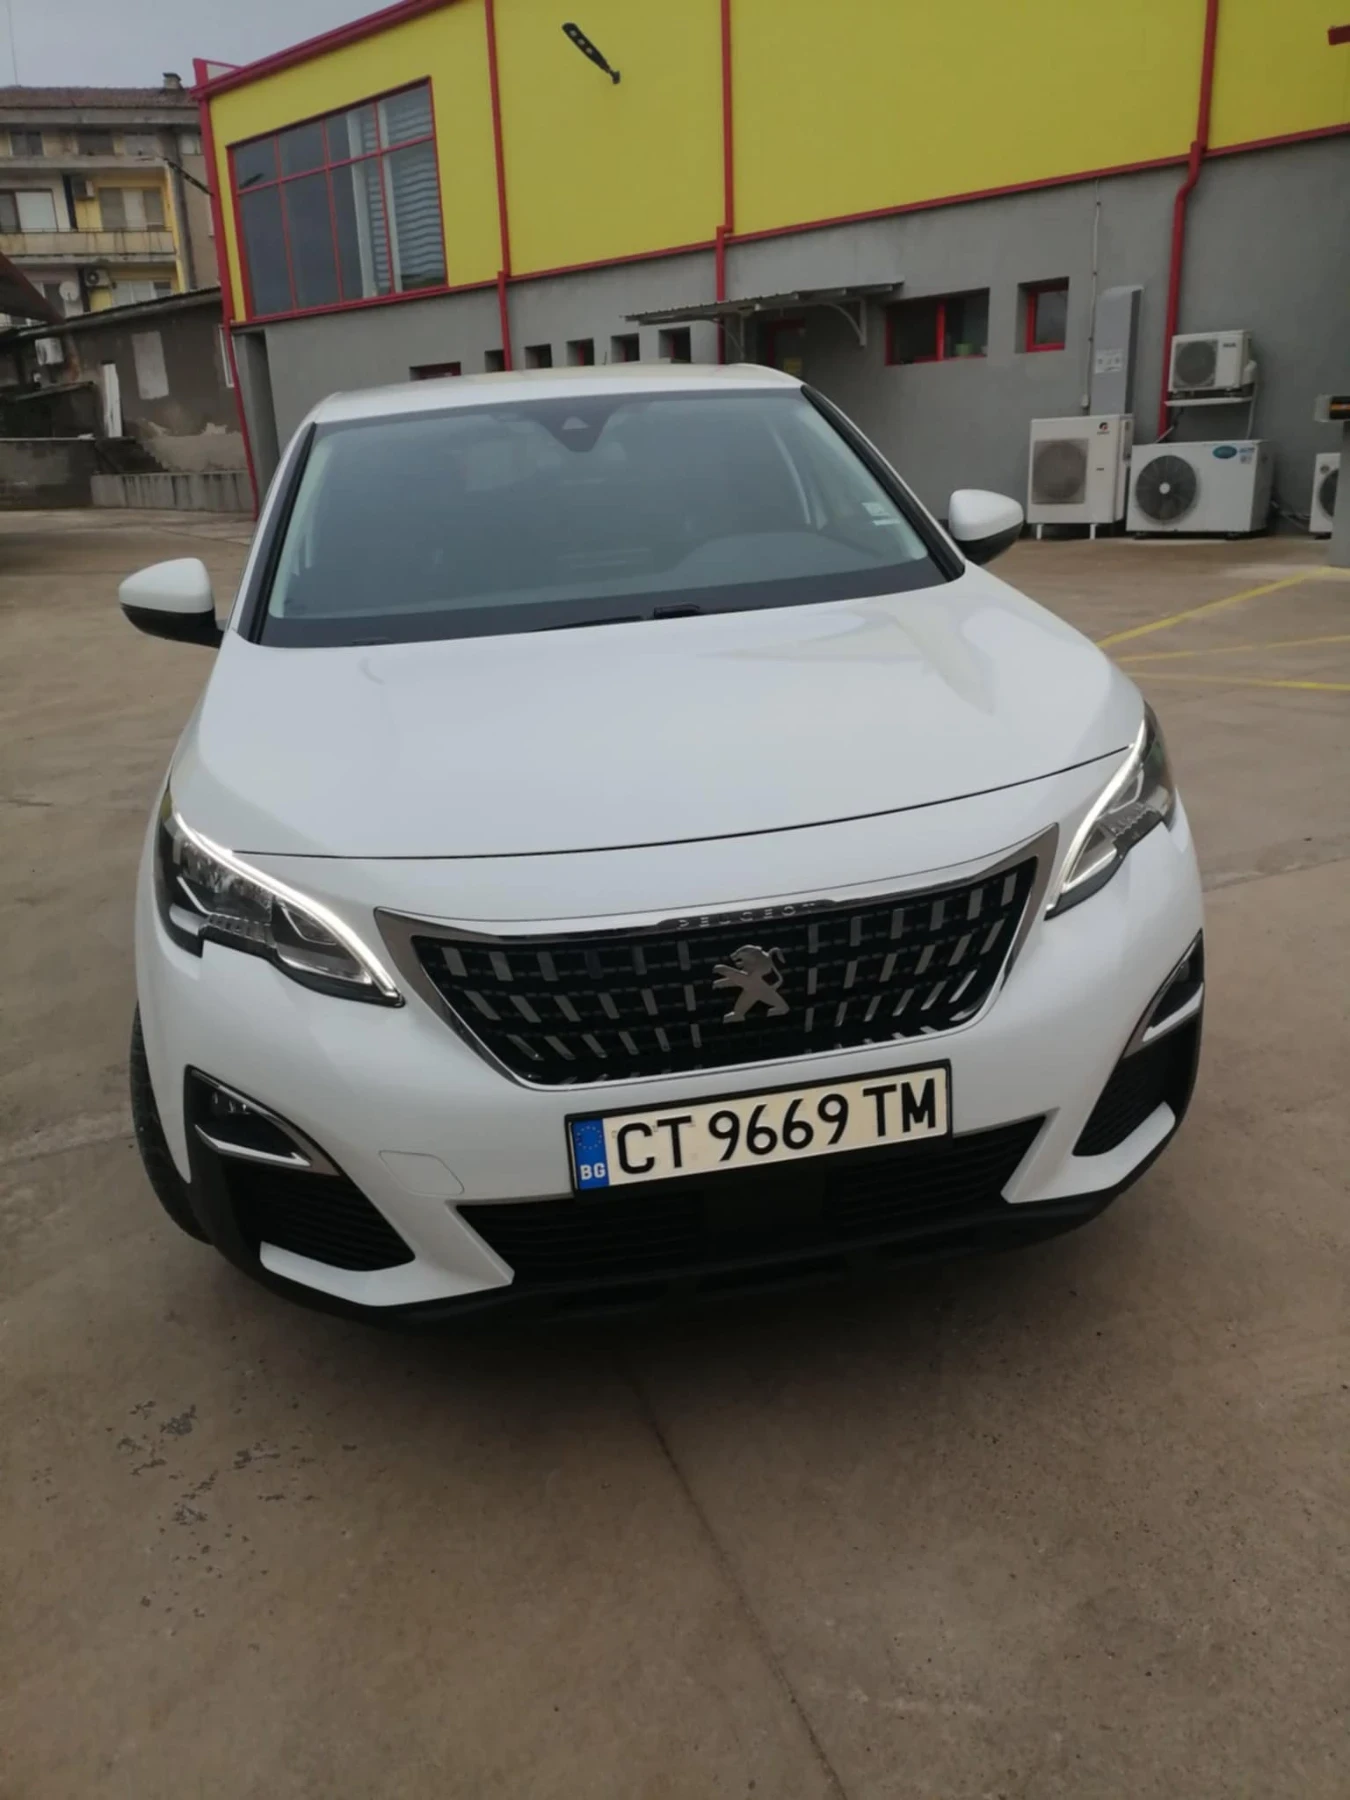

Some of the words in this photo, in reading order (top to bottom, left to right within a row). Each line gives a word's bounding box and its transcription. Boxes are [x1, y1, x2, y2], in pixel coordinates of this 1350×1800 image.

[617, 1116, 692, 1175] CT
[708, 1093, 849, 1162] 9669
[862, 1078, 937, 1138] TM
[580, 1162, 606, 1180] BG
